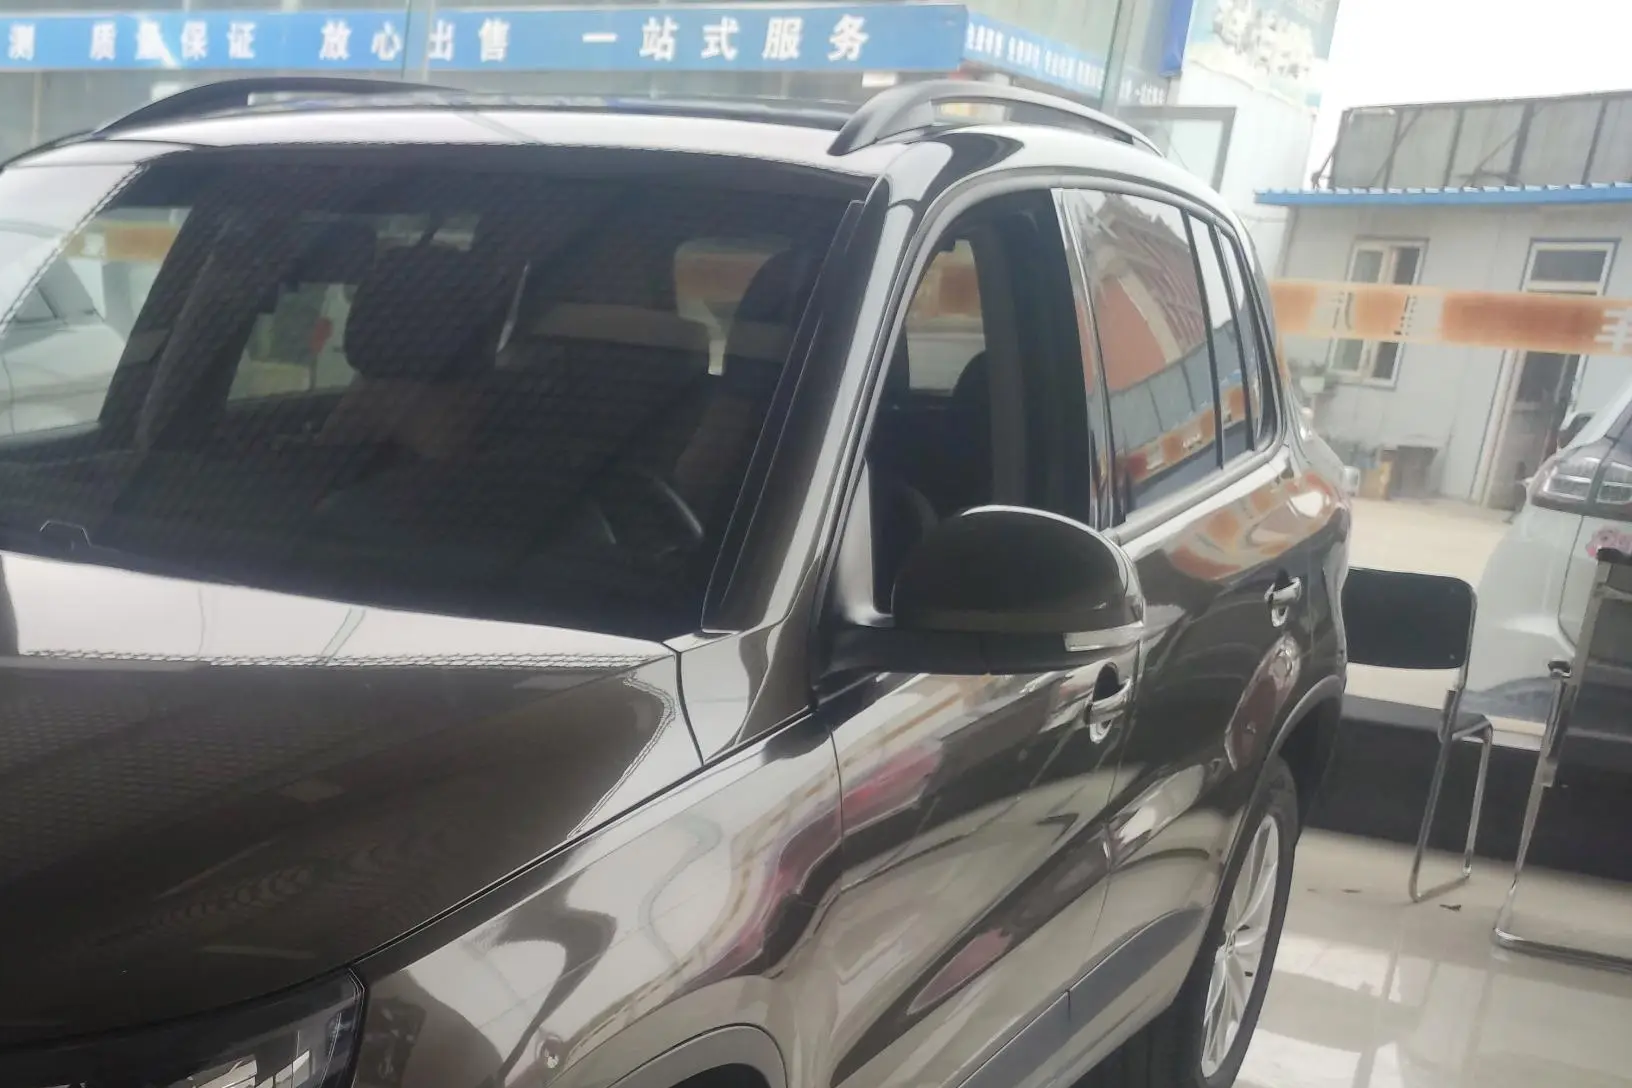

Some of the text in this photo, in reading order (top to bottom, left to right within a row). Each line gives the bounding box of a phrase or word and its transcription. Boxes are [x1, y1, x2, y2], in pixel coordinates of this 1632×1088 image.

[318, 17, 511, 62] 放心出售
[581, 14, 870, 62] 一站式服务
